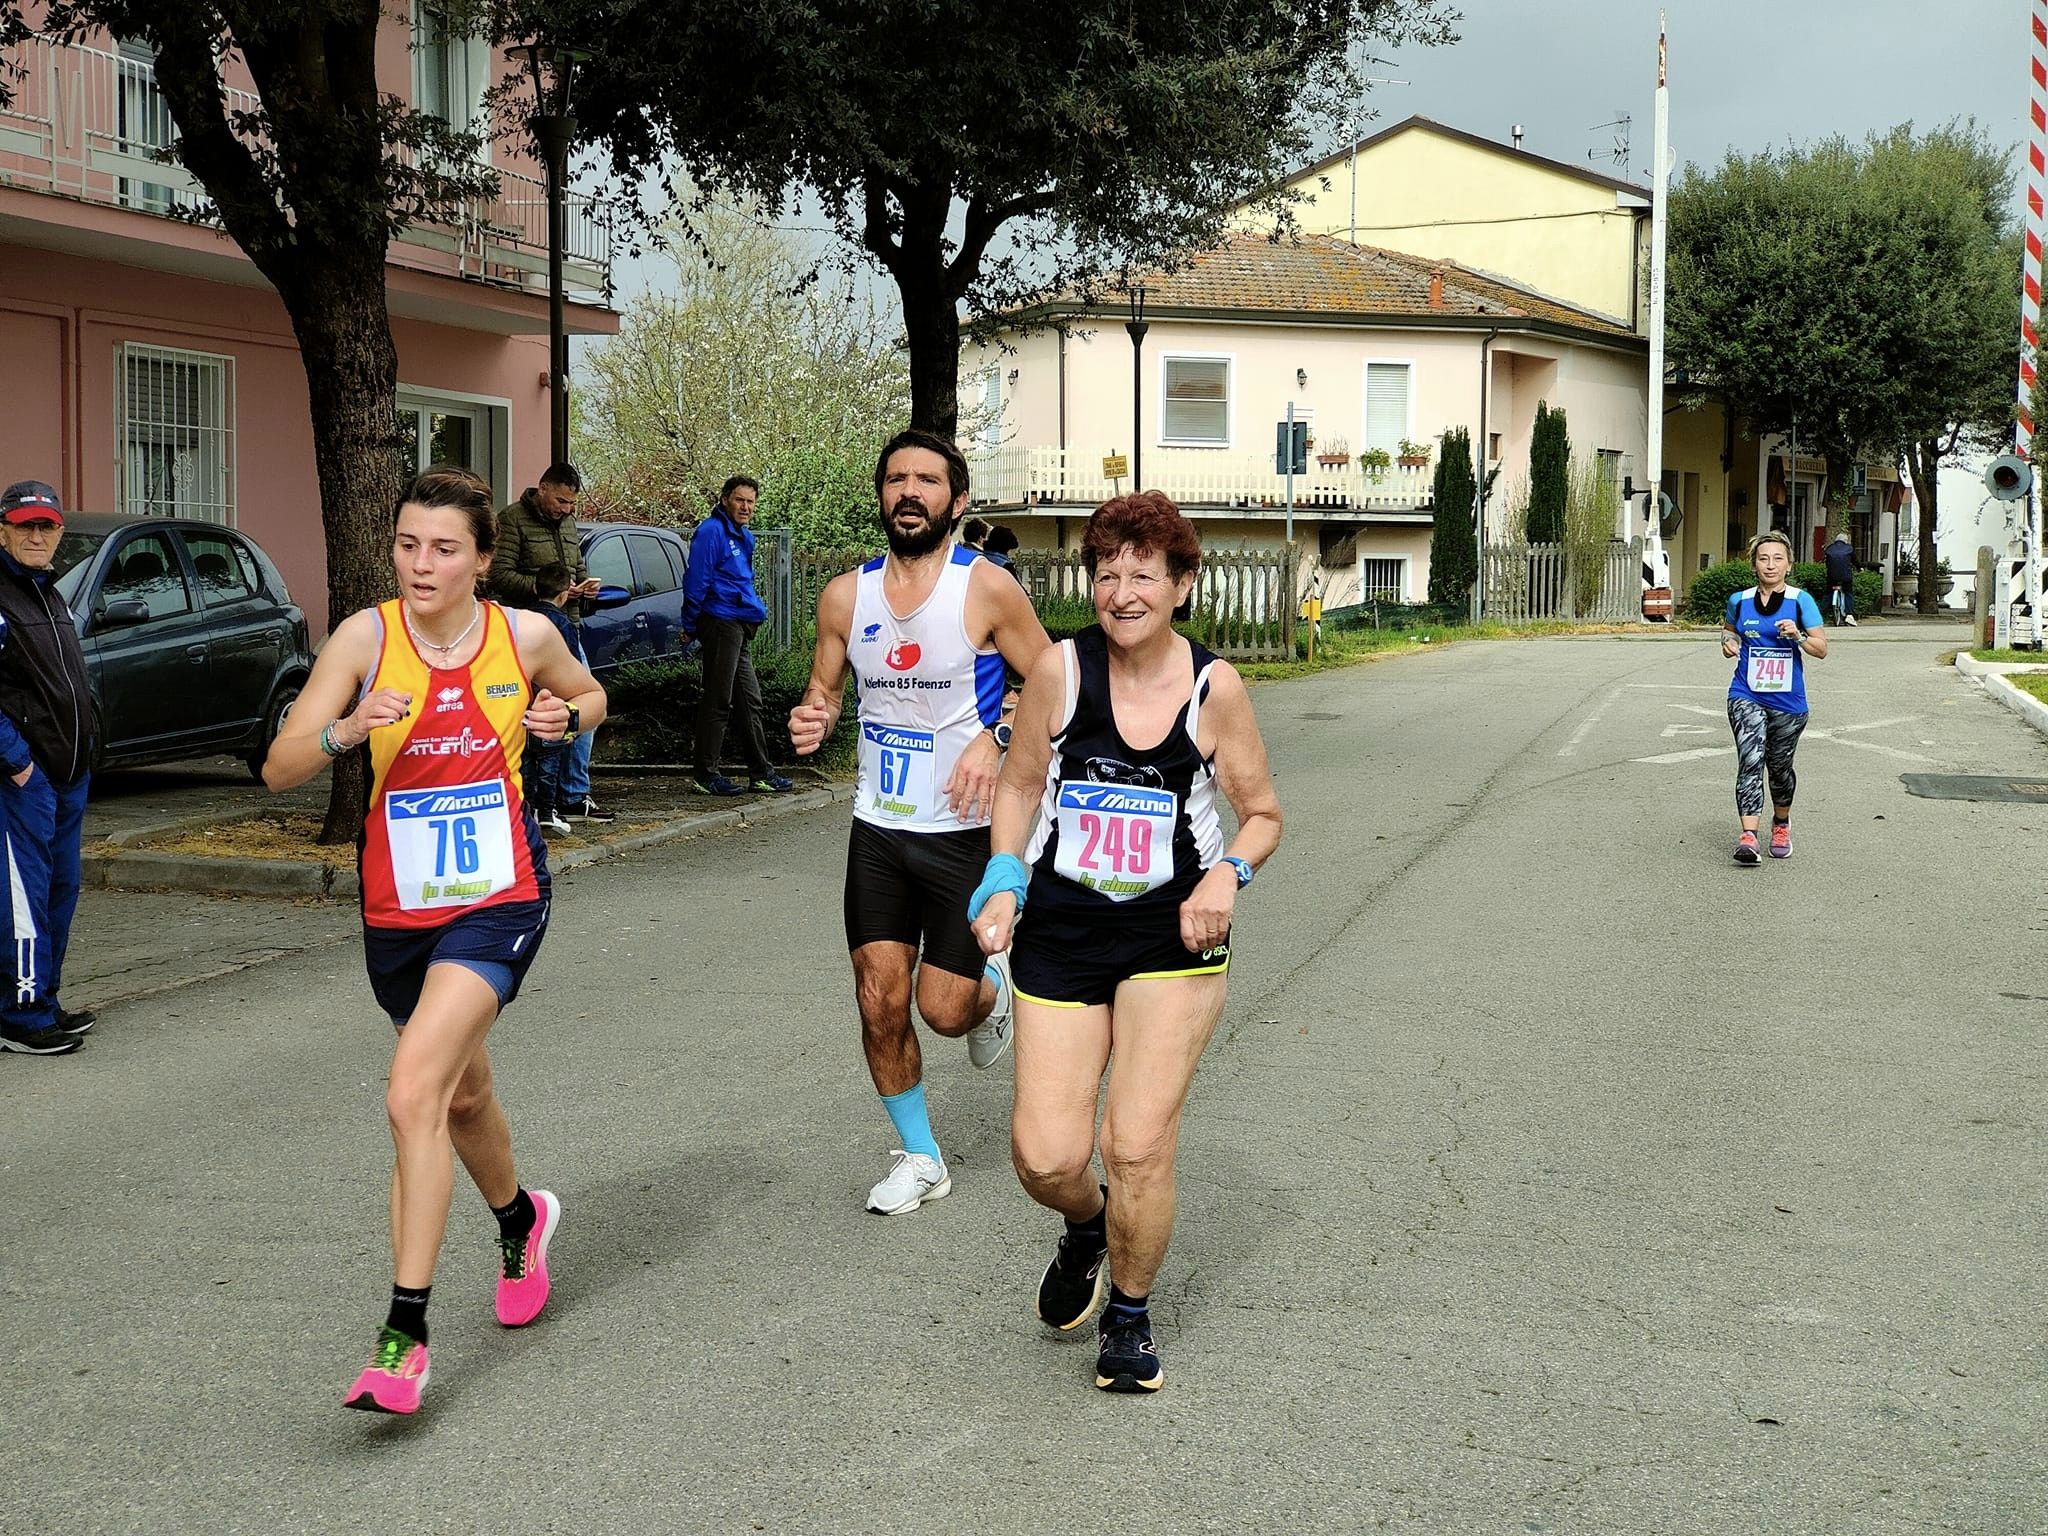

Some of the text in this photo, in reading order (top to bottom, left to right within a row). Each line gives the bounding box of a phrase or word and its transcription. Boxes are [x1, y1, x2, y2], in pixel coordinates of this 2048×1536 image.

[897, 677, 910, 690] 85
[912, 677, 952, 690] Faenza
[1755, 659, 1785, 681] 244
[486, 682, 520, 695] BERARDI
[880, 749, 911, 797] 67
[428, 816, 479, 877] 76
[1077, 813, 1153, 875] 249
